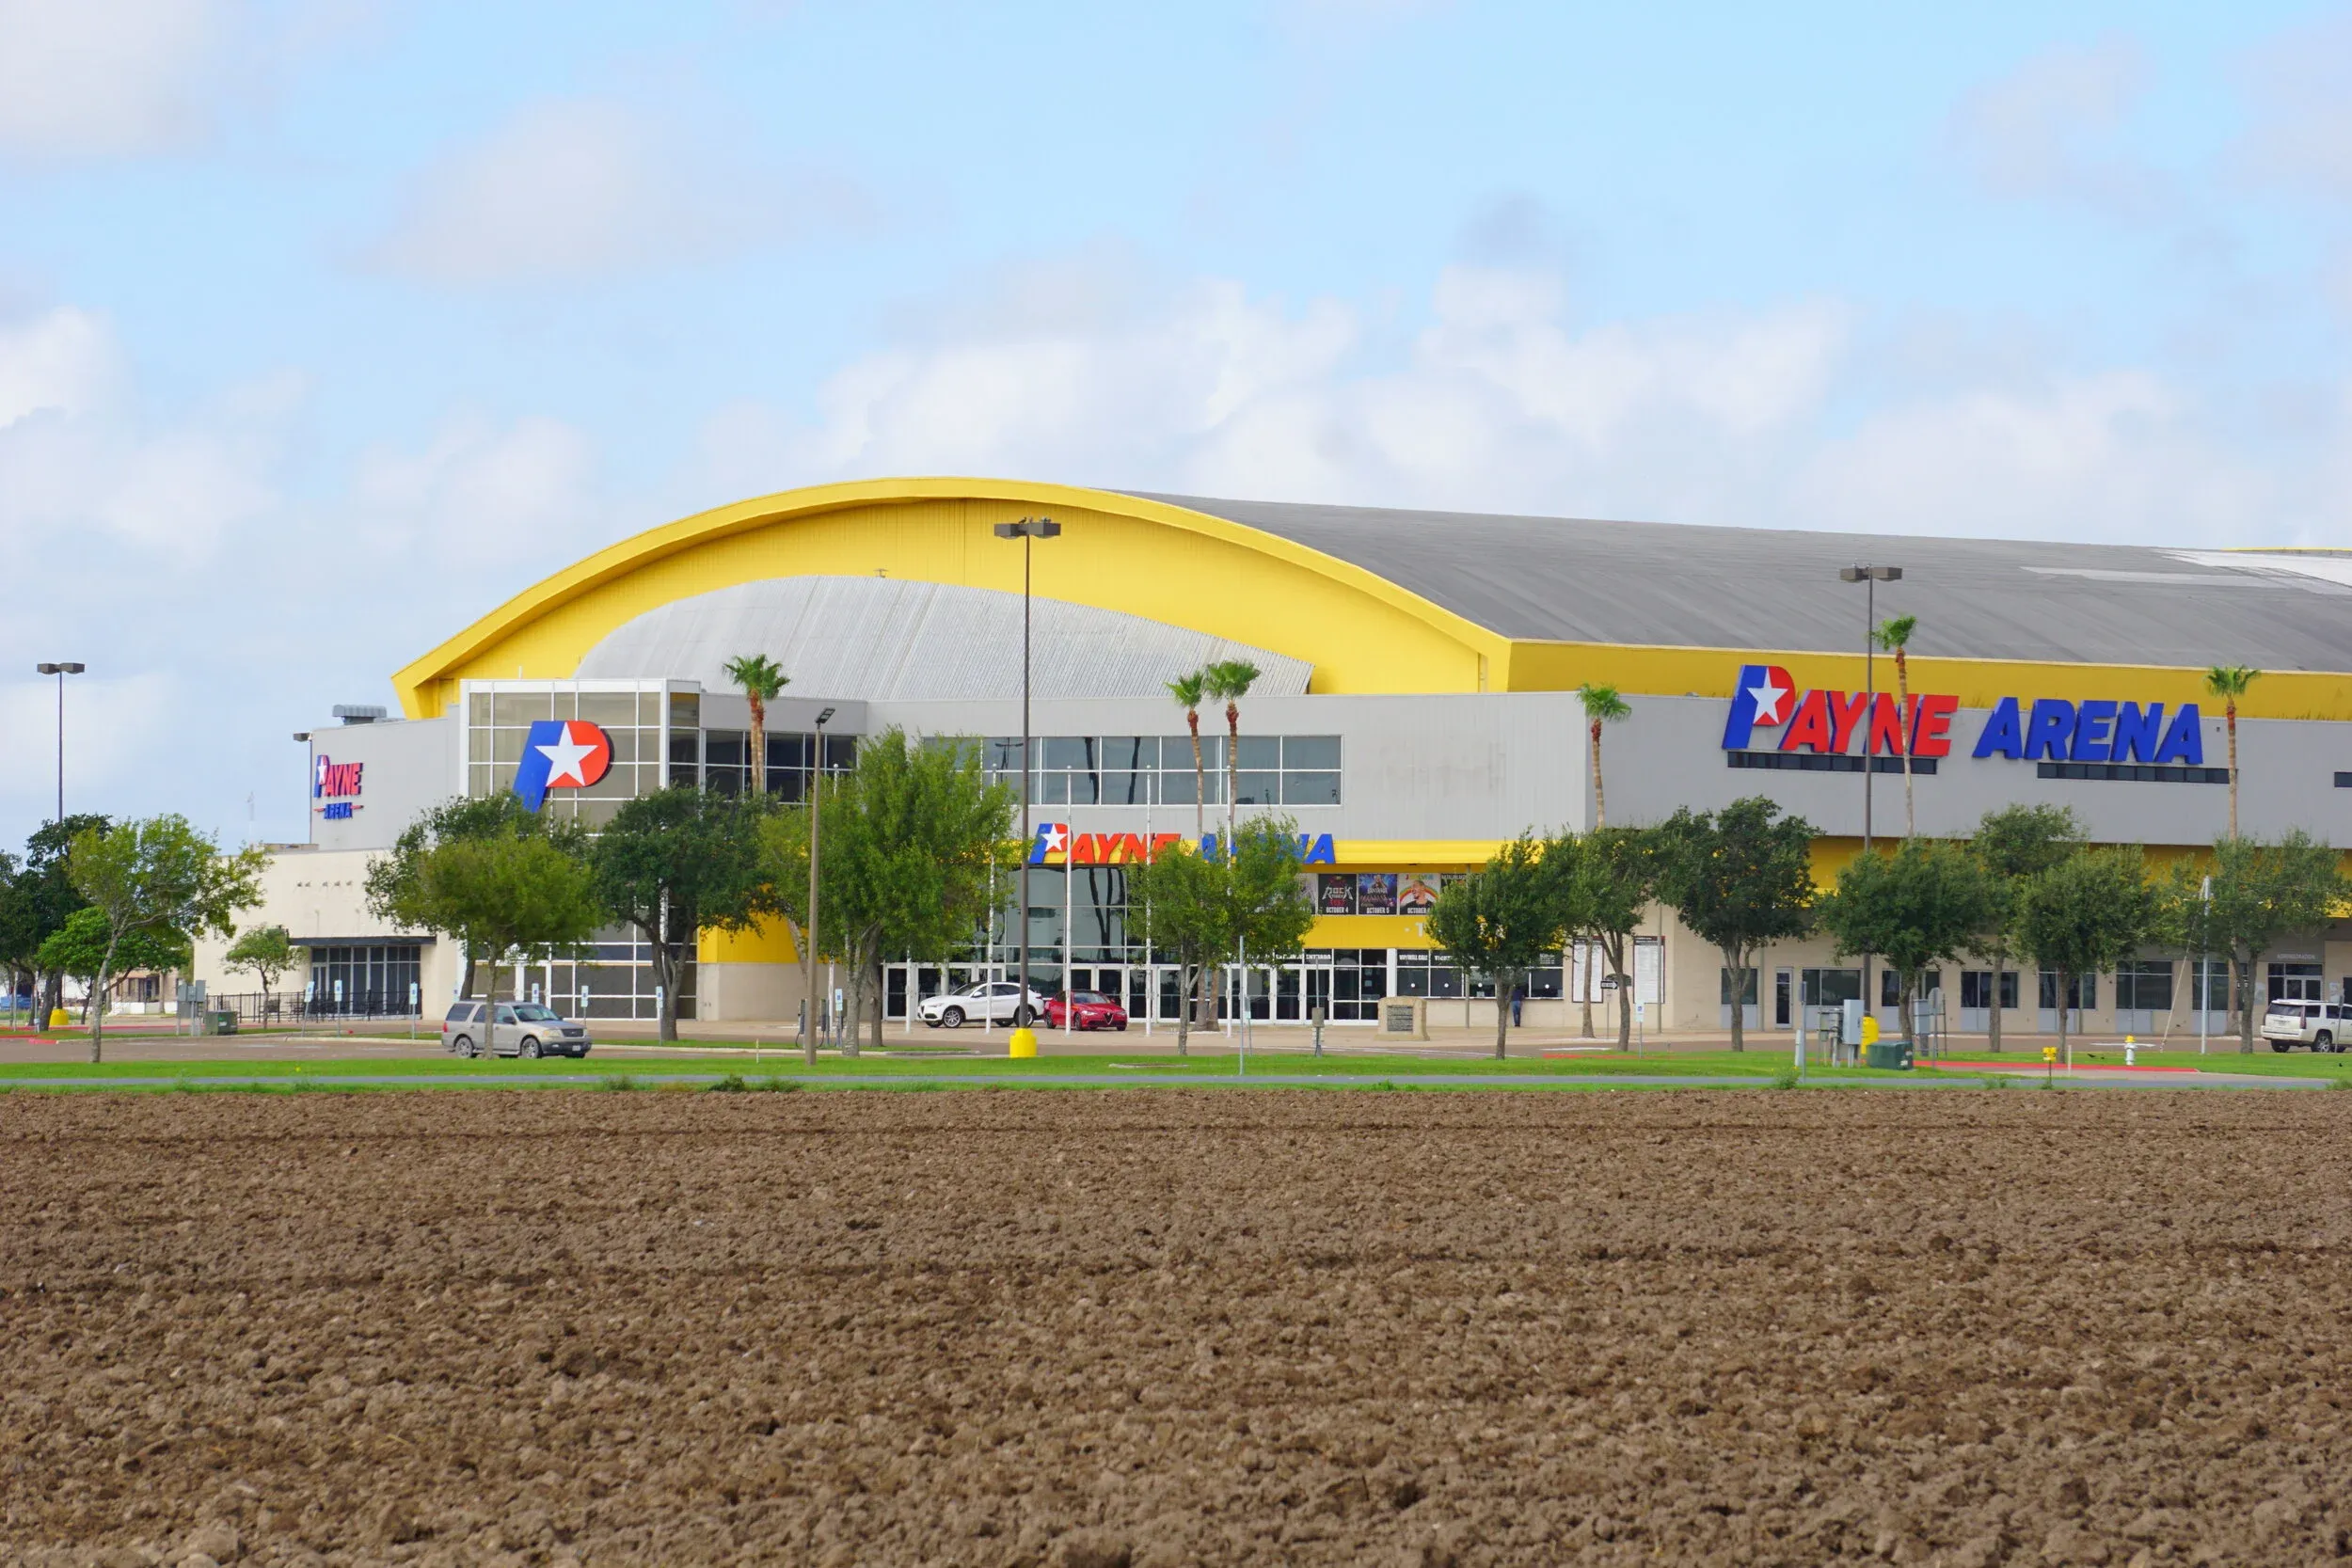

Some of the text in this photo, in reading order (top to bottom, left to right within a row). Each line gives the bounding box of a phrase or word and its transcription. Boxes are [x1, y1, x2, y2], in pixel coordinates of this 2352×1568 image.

[1722, 664, 2203, 765] PAYNE ARENA
[313, 754, 363, 798] PAYNE
[324, 801, 353, 819] ARENA
[1191, 833, 1336, 864] ANA
[1322, 885, 1354, 900] ROCK
